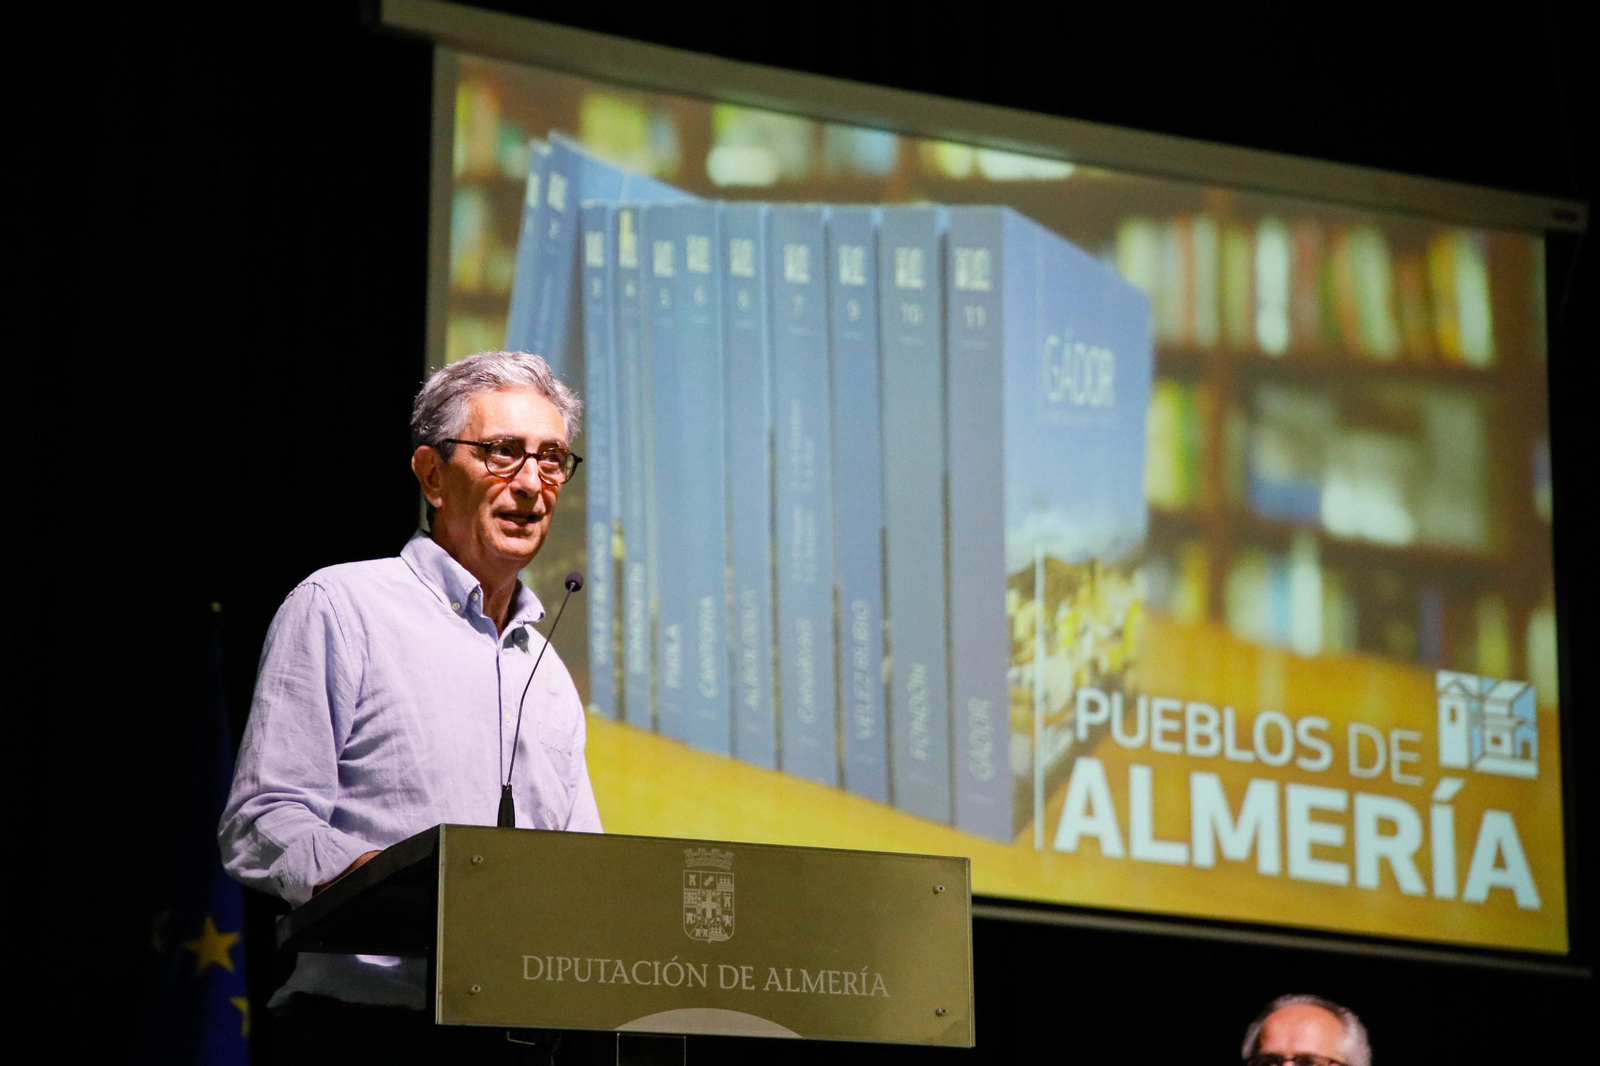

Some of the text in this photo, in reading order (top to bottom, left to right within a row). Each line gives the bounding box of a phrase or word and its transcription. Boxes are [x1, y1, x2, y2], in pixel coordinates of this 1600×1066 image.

[902, 302, 923, 327] 10
[965, 304, 986, 329] 11
[1043, 328, 1115, 407] GÁDOR
[1076, 687, 1423, 786] PUEBLOS DE
[1053, 756, 1542, 911] ALMERÍA
[521, 954, 891, 998] DIPUTACIÓN DE ALMERÍA
